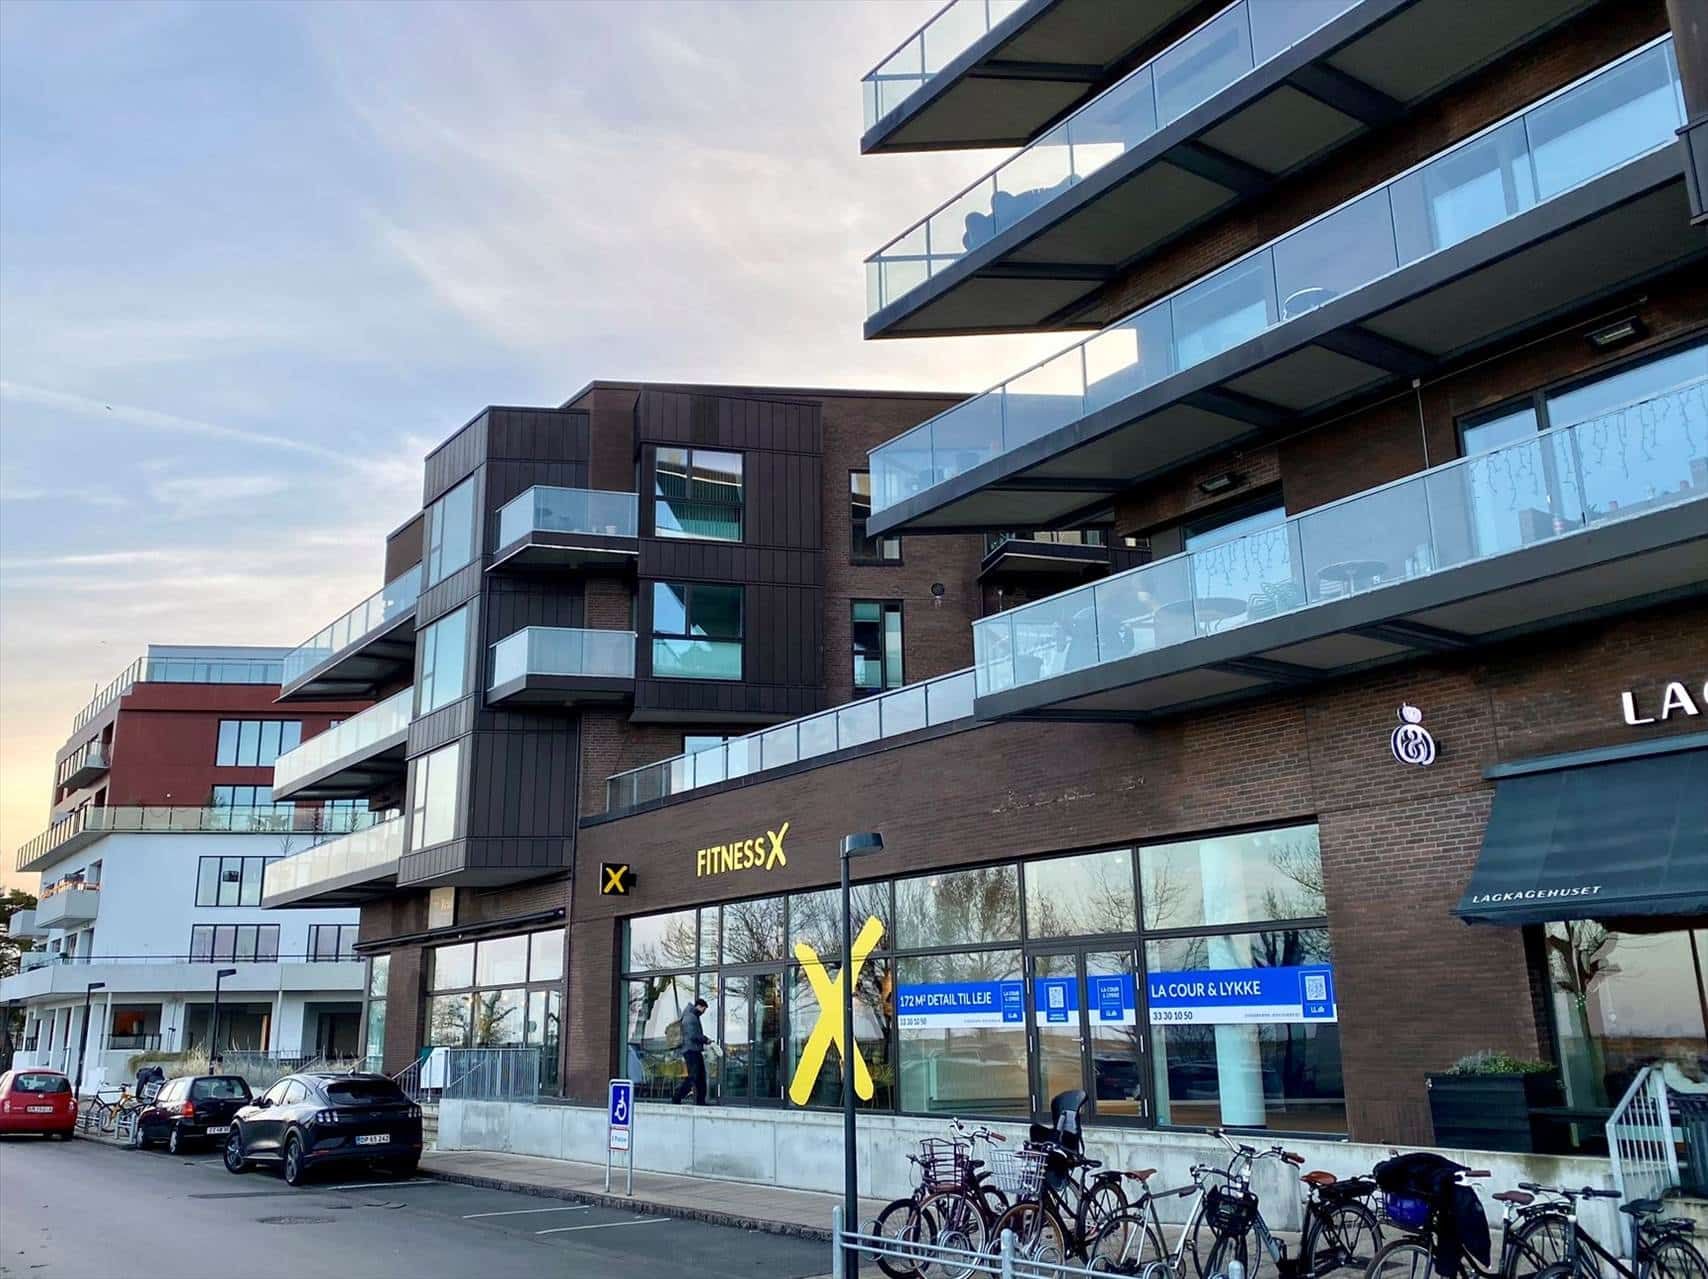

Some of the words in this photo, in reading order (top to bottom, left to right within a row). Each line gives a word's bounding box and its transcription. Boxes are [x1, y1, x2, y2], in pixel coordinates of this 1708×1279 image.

[1621, 681, 1708, 726] LA
[603, 865, 628, 894] X
[1472, 885, 1602, 904] LAGKAGEHUSET
[900, 995, 914, 1007] 172
[927, 993, 957, 1006] DETAIL
[958, 992, 972, 1005] TIL
[972, 991, 992, 1004] LEJE
[1151, 984, 1166, 998] LA
[1168, 983, 1206, 997] COUR
[1208, 982, 1217, 996] &
[1219, 981, 1261, 996] LYKKE
[789, 915, 885, 1106] X
[1152, 1011, 1163, 1021] 33
[1163, 1011, 1173, 1020] 30
[1174, 1011, 1183, 1020] 10
[1183, 1011, 1193, 1020] 50
